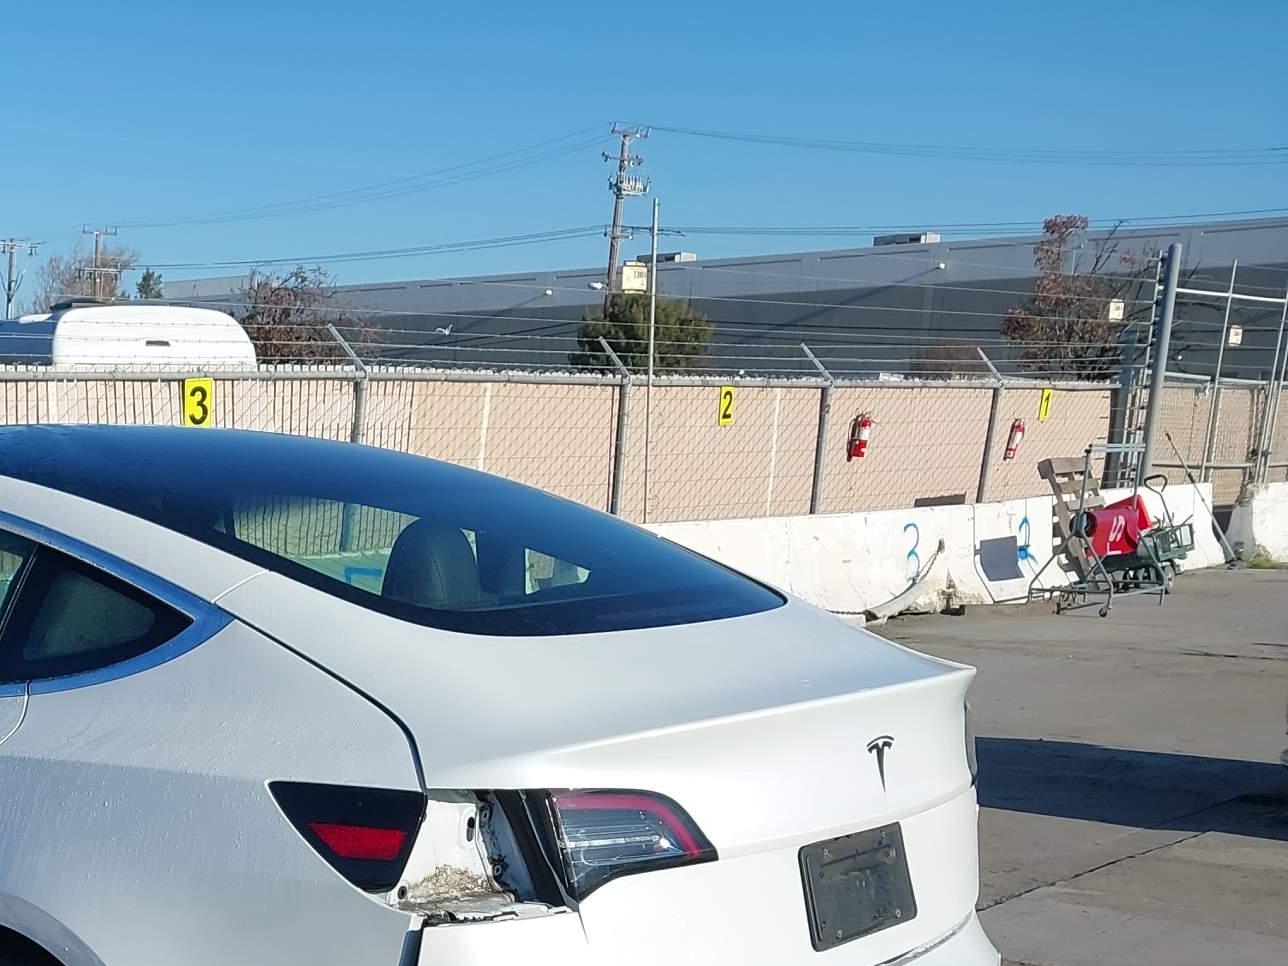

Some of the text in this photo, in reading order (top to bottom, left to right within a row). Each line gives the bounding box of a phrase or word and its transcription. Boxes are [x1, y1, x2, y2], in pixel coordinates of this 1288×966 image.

[189, 386, 208, 425] 3
[722, 391, 733, 419] 2
[1044, 392, 1051, 417] 1
